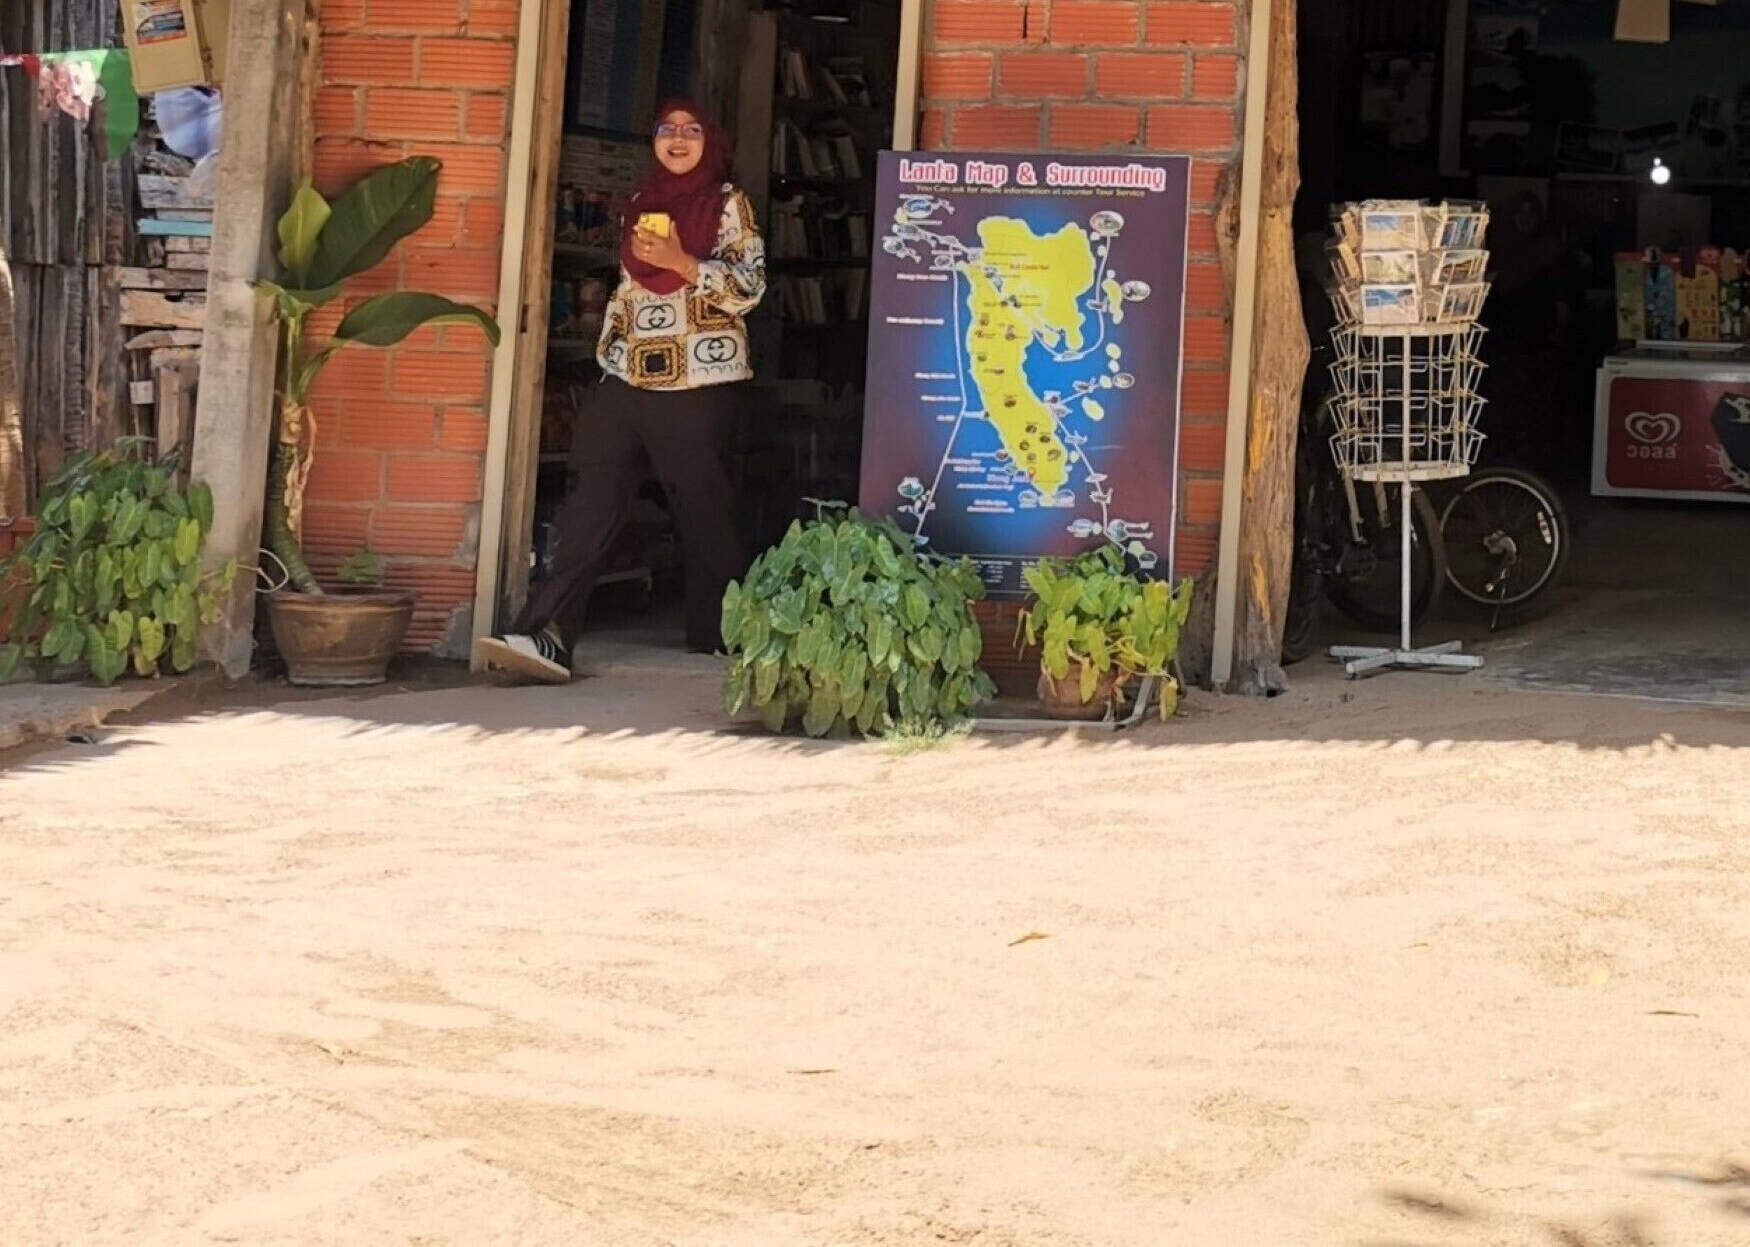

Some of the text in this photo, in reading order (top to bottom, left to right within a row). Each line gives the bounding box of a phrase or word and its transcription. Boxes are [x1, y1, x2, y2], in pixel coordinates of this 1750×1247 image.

[900, 159, 1166, 191] Lanta Map & Surrounding
